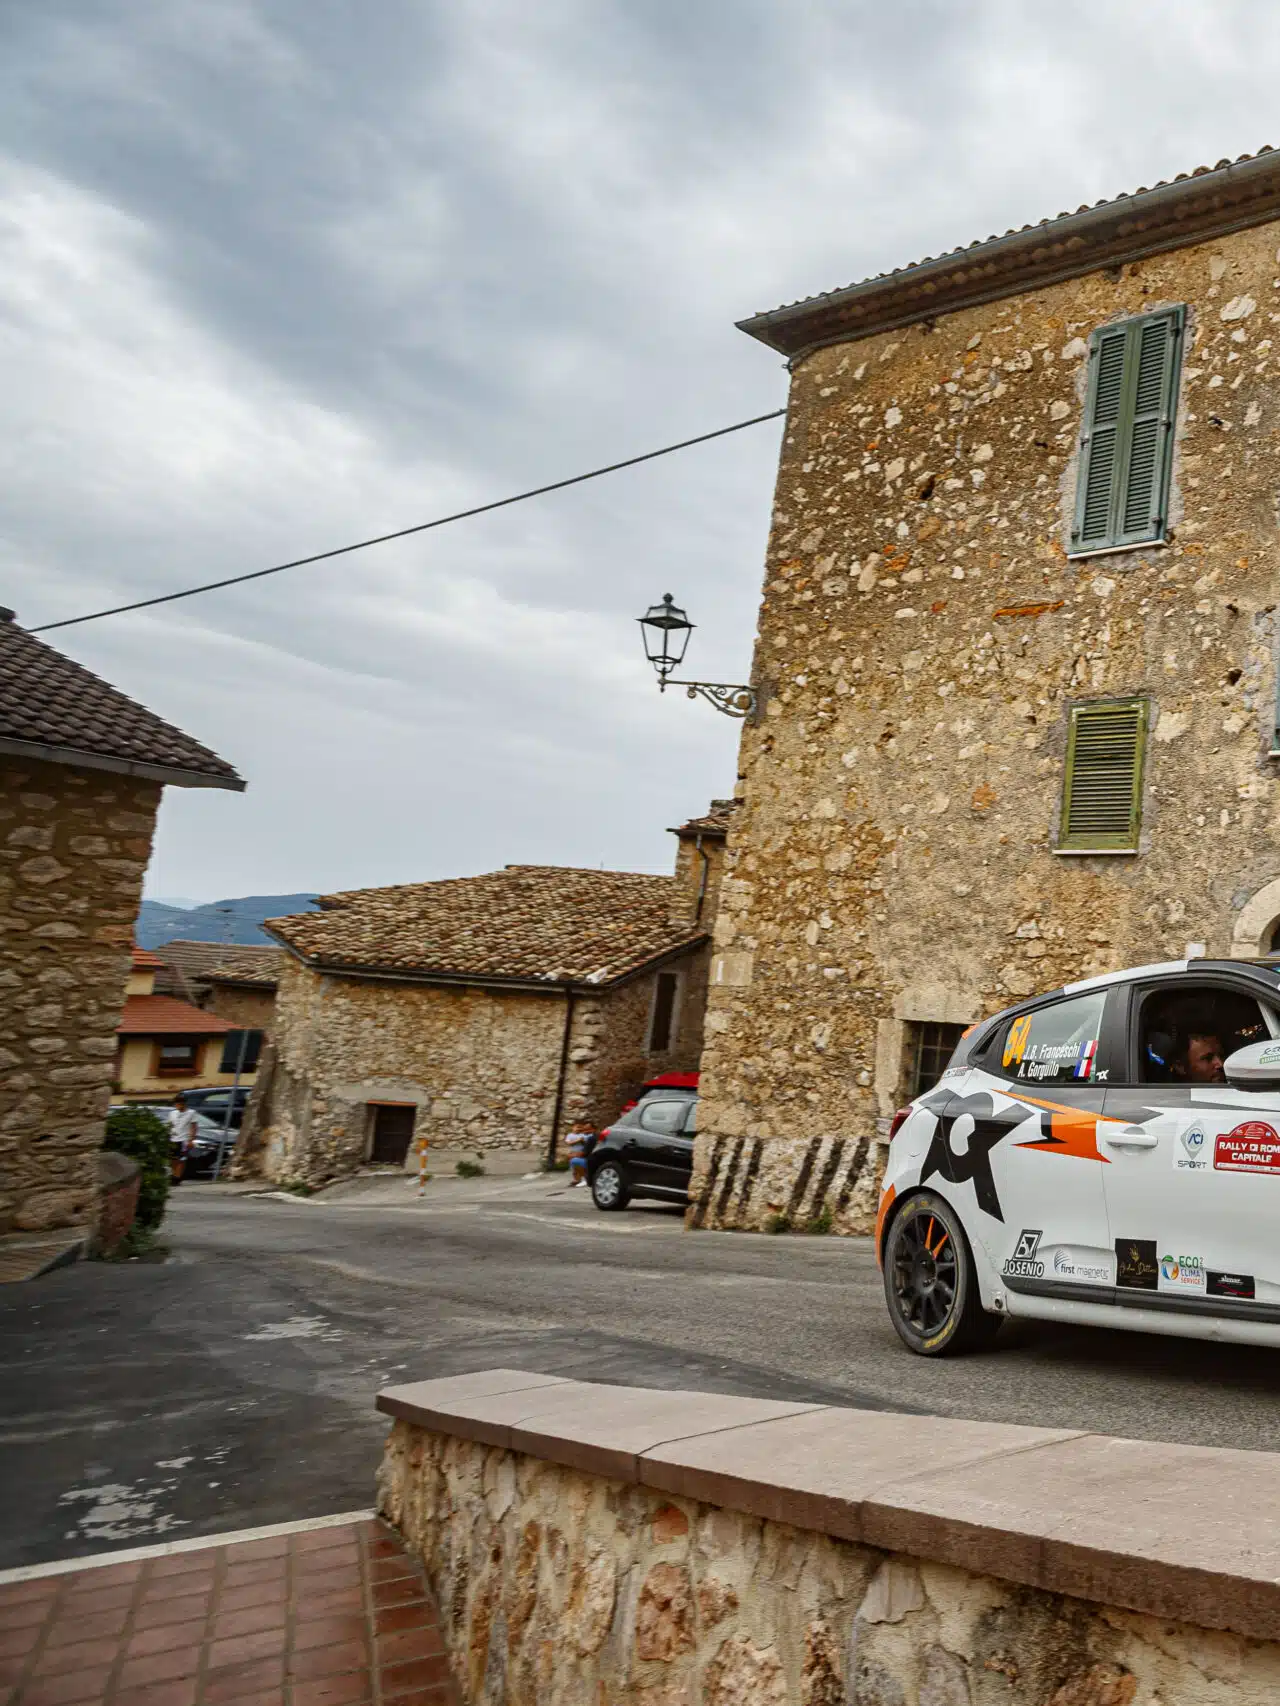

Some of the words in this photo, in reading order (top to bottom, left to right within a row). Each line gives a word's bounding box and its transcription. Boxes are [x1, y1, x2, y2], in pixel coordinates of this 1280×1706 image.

[1003, 1015, 1032, 1067] 54
[1023, 1044, 1038, 1060] J.B.
[1039, 1041, 1081, 1059] Franceschi
[1017, 1062, 1026, 1078] A.
[1027, 1060, 1060, 1080] Gorguilo
[1188, 1133, 1204, 1145] ACI
[1219, 1141, 1247, 1150] RALLY
[1177, 1160, 1207, 1168] SPORT
[1231, 1152, 1272, 1163] CAPITALE
[1003, 1259, 1044, 1277] JOSENIO
[1179, 1255, 1199, 1269] ECO
[1061, 1263, 1075, 1275] first
[1077, 1265, 1109, 1280] magnetic
[1180, 1268, 1200, 1277] CLIMA
[1180, 1277, 1201, 1285] SERVICE
